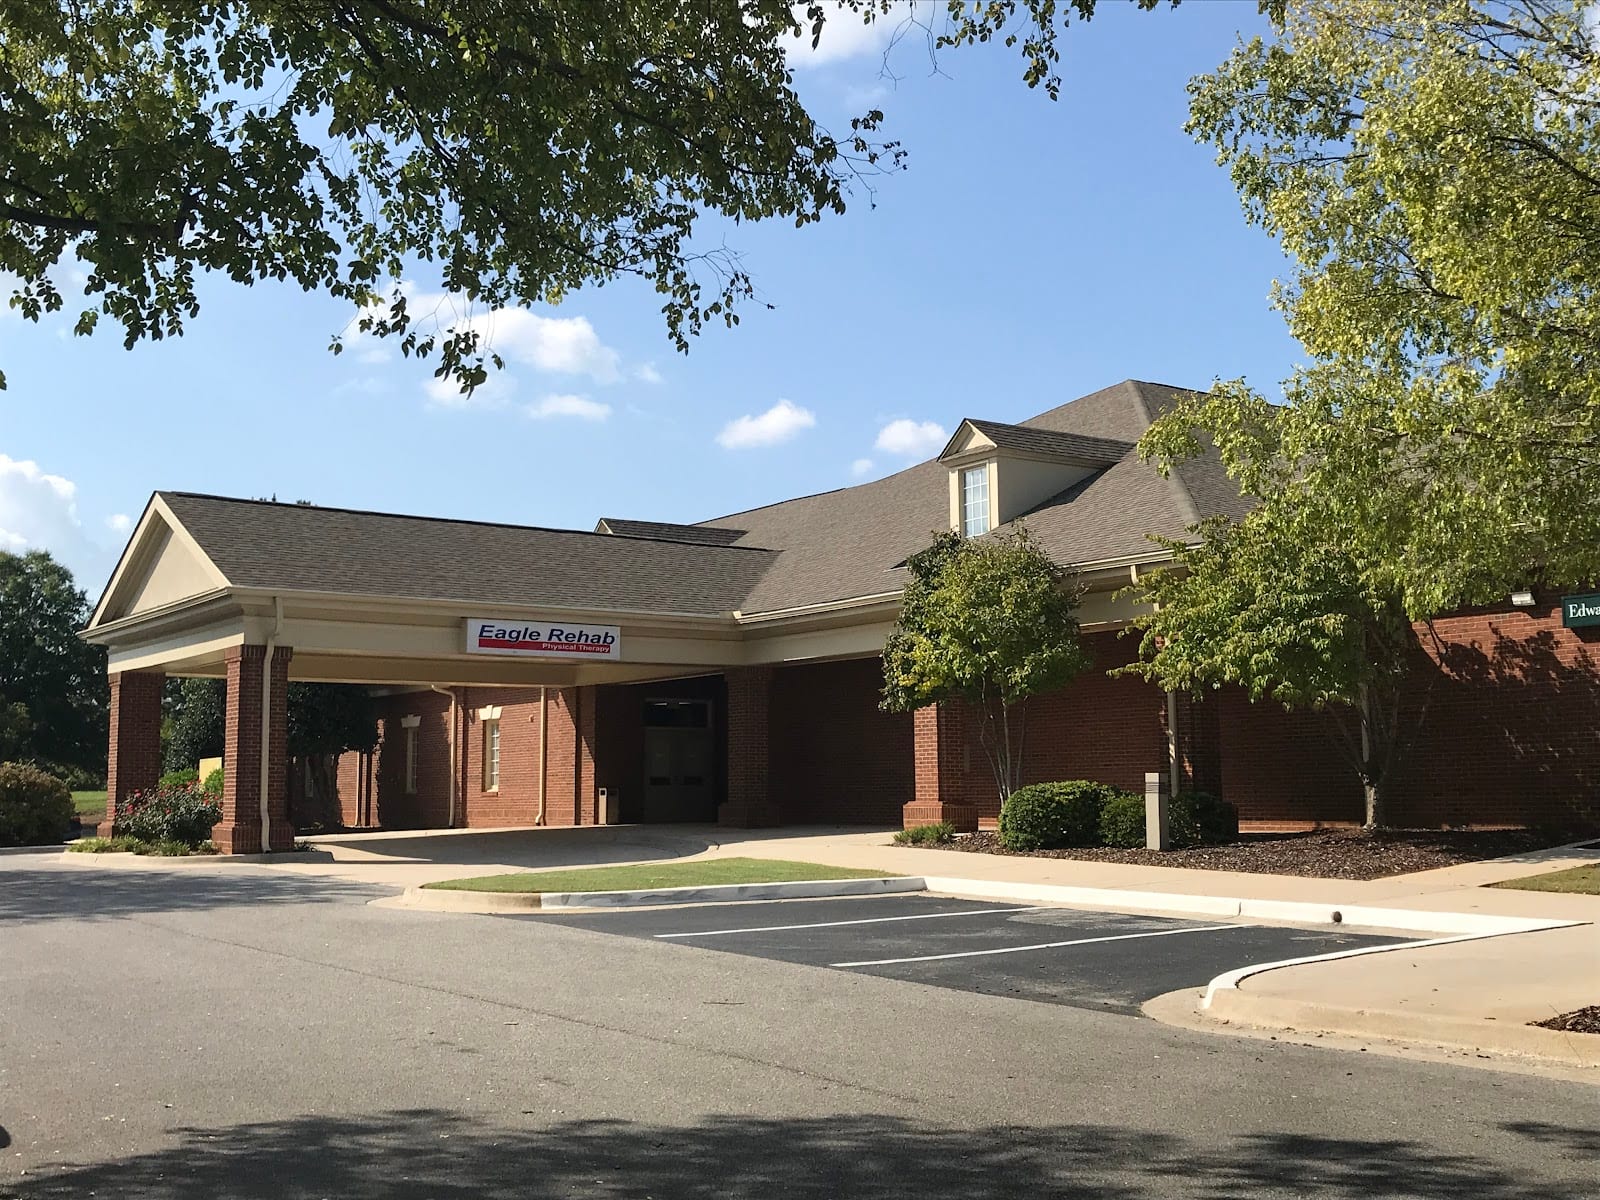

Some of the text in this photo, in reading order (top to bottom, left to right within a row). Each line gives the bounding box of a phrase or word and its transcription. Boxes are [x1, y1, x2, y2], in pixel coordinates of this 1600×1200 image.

[1567, 603, 1600, 618] Edwa
[479, 624, 615, 645] Eagle Rehab
[542, 642, 610, 653] Physical Therapy
